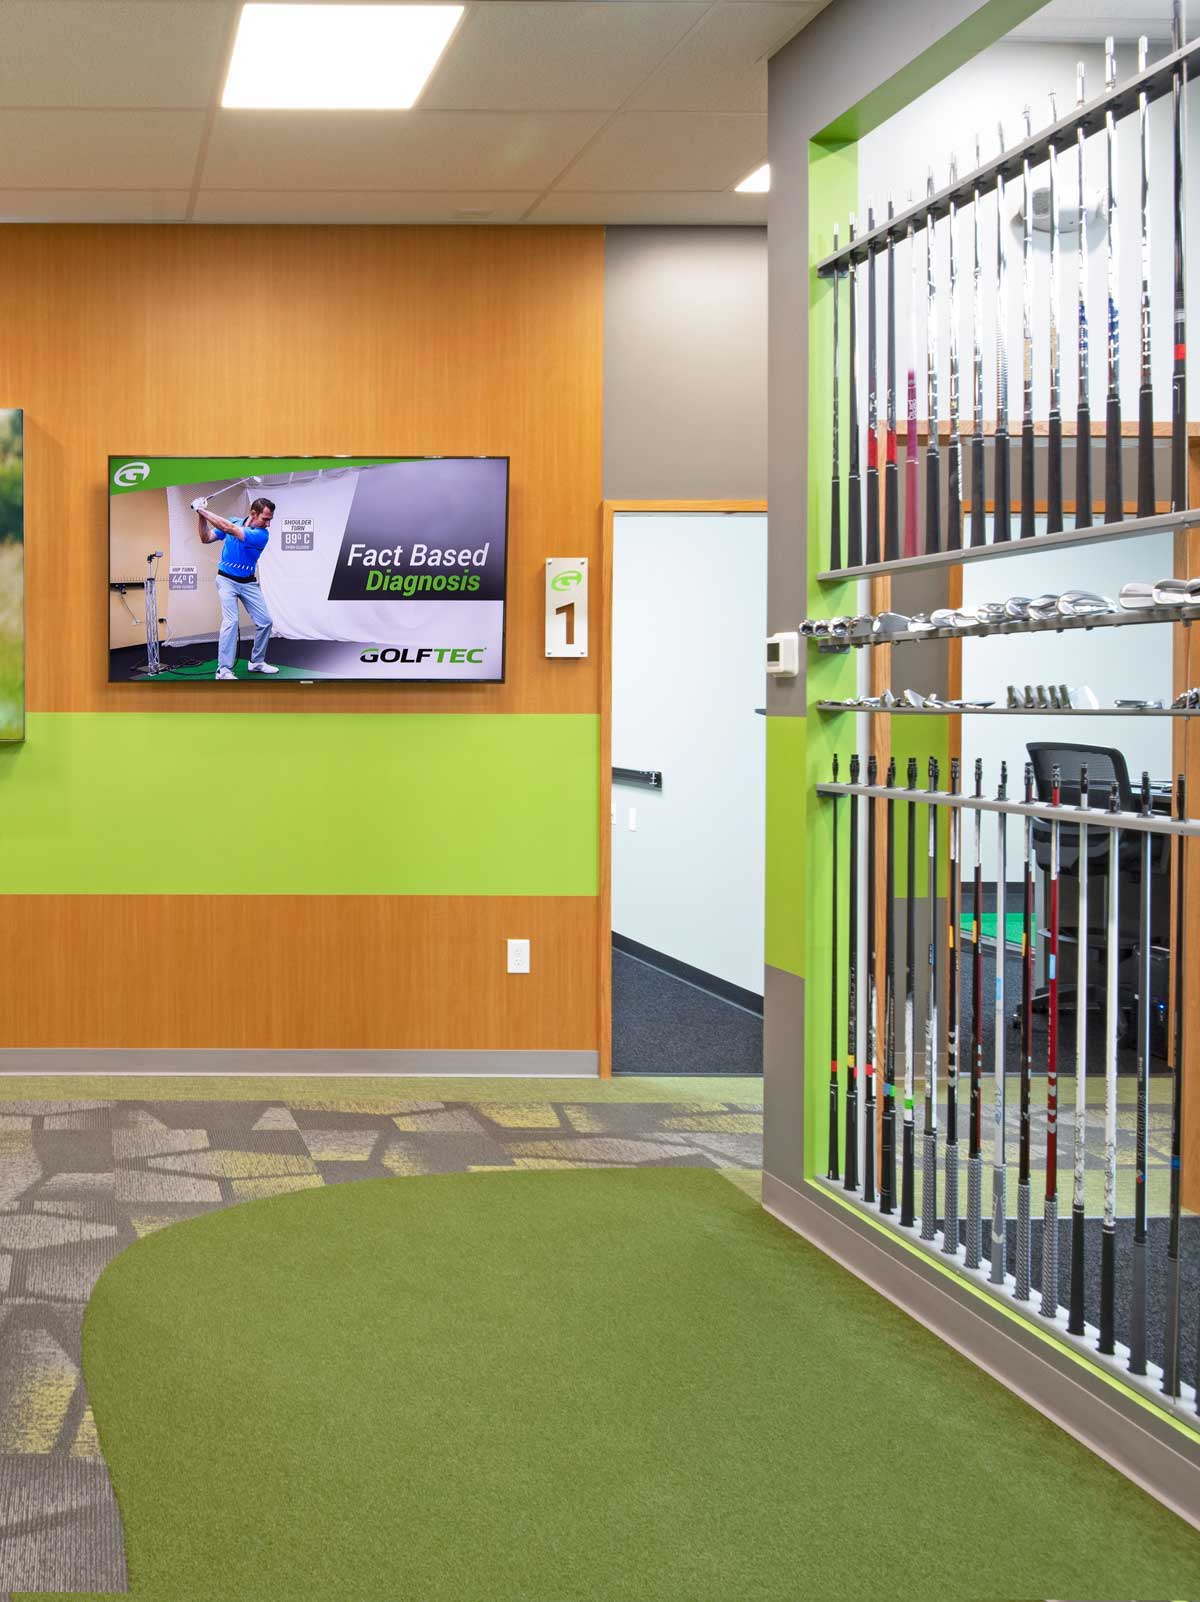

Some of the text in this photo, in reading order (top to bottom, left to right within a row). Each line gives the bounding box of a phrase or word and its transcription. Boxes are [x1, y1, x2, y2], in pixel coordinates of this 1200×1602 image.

[347, 542, 490, 566] Fact Based
[365, 569, 481, 596] Diagnosis
[555, 602, 575, 645] 1
[359, 648, 484, 663] GOLFTEC
